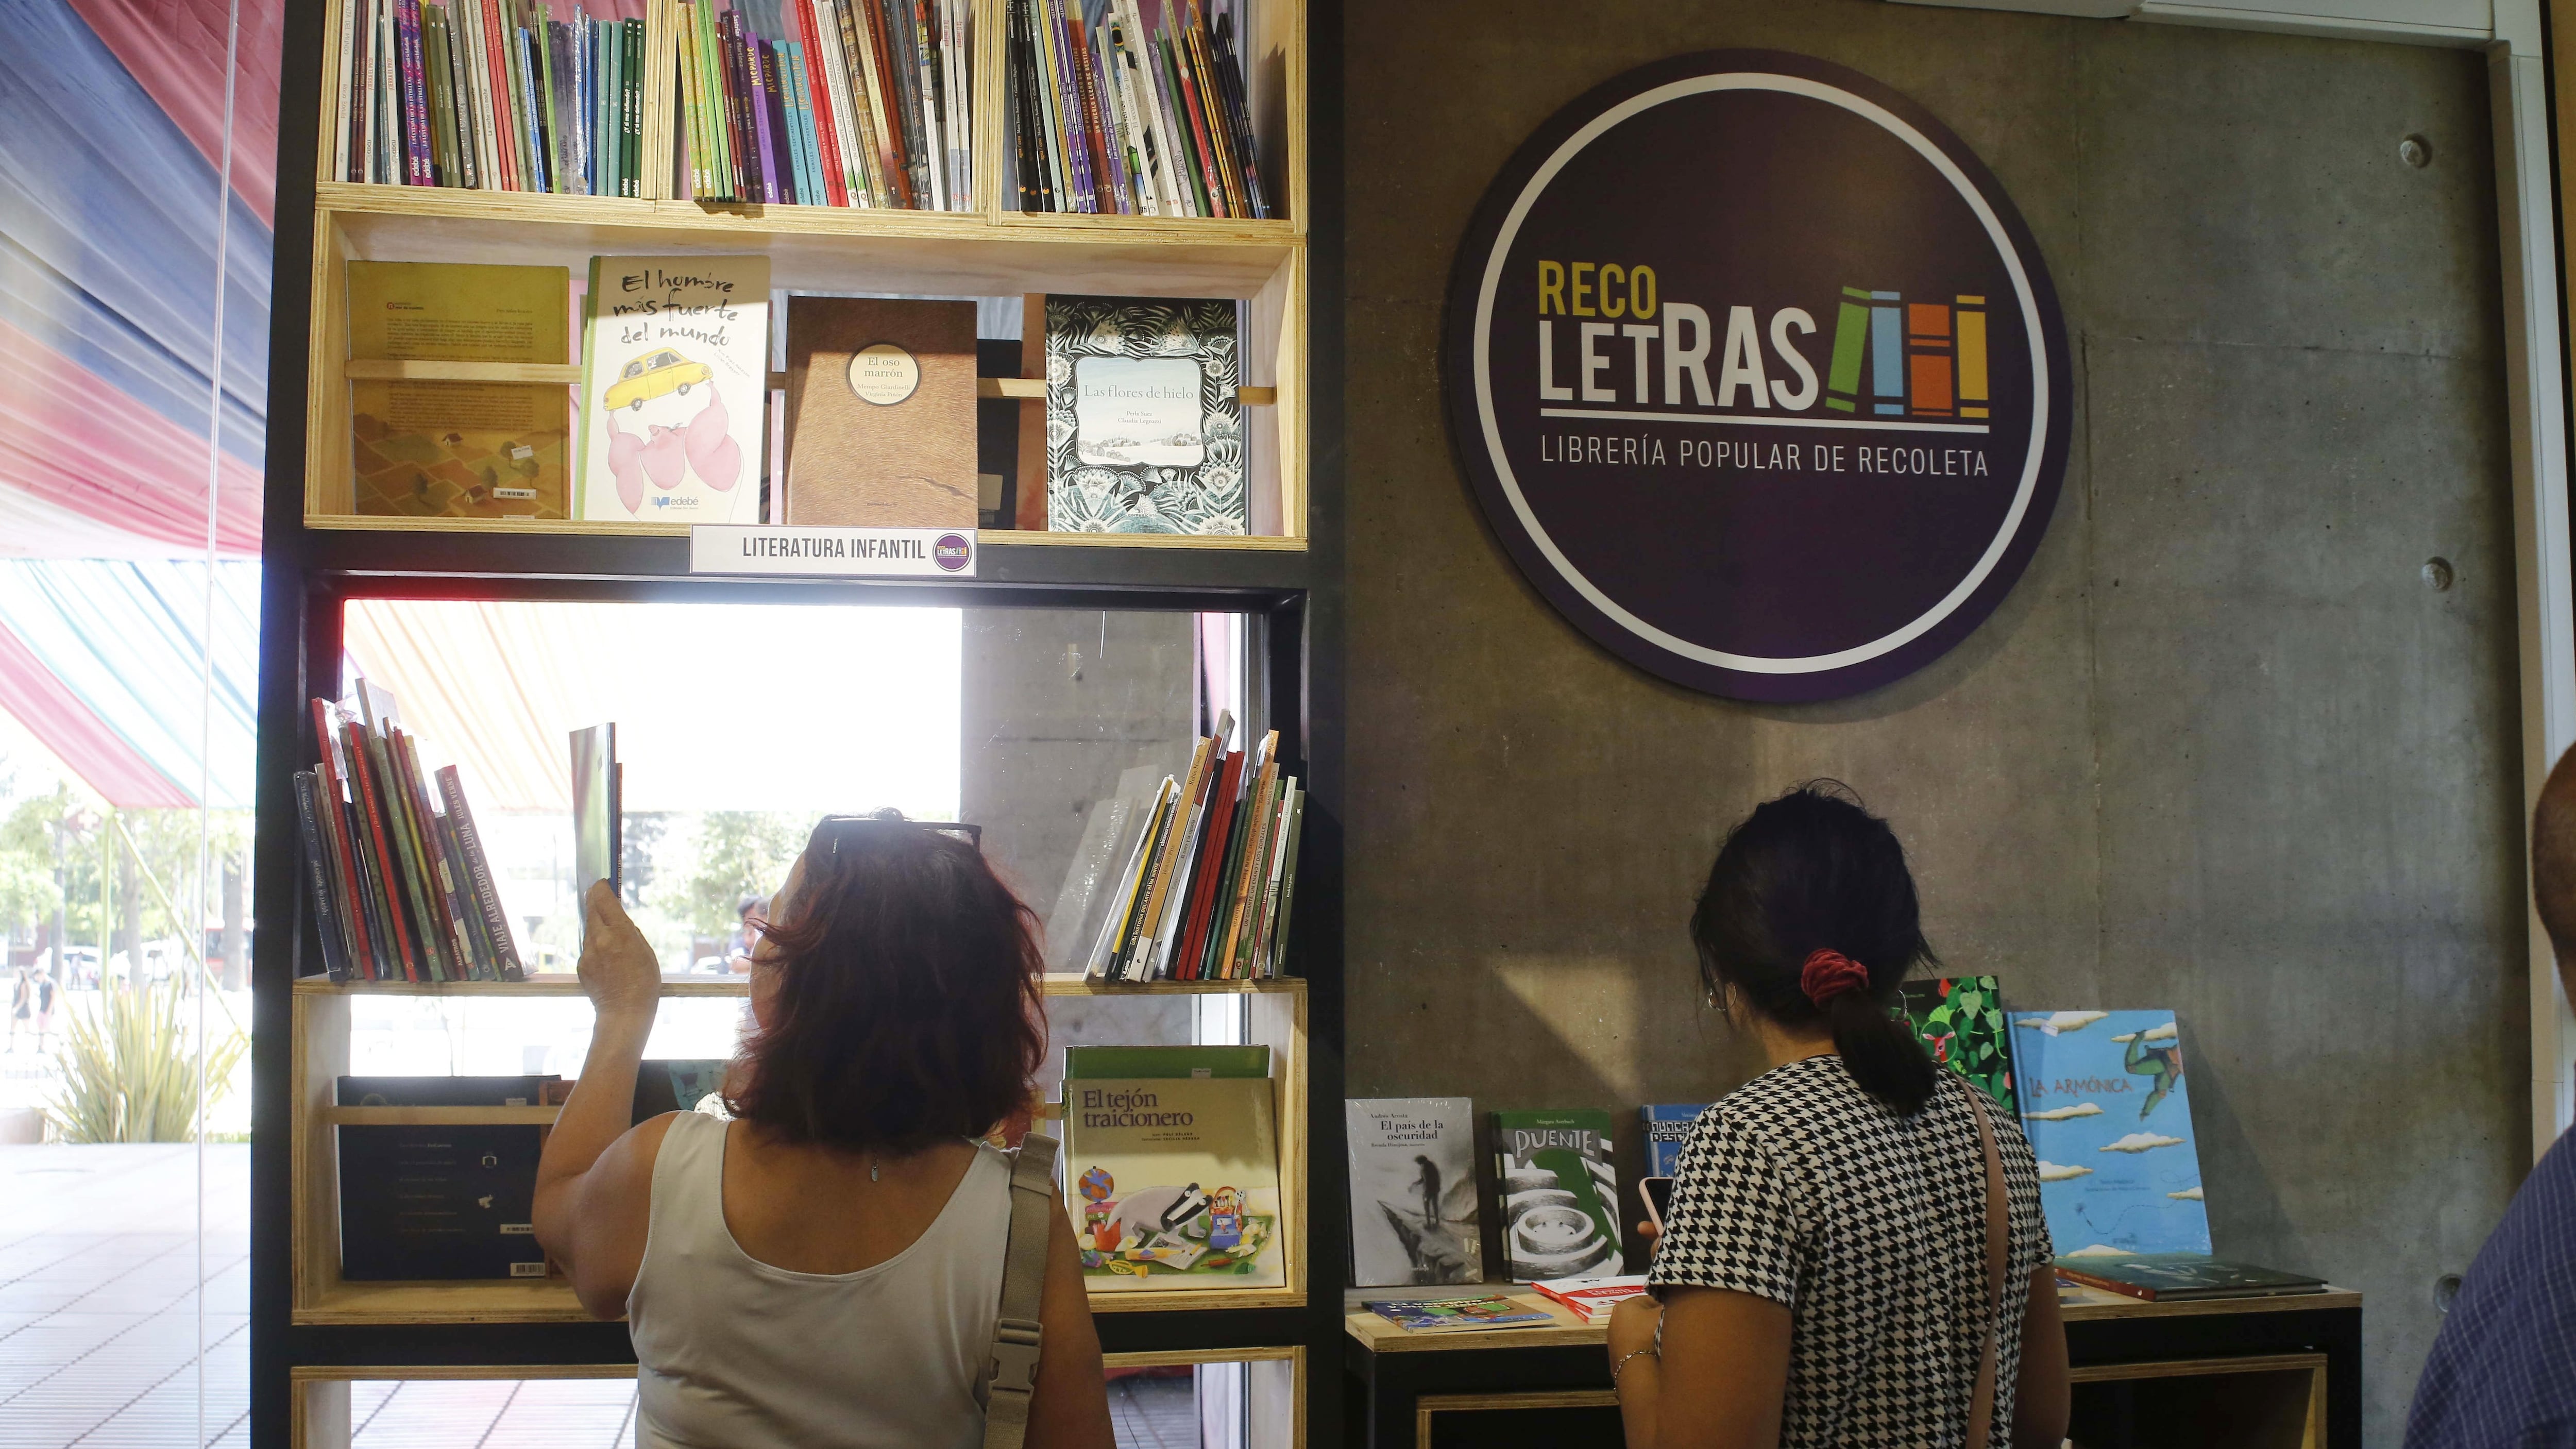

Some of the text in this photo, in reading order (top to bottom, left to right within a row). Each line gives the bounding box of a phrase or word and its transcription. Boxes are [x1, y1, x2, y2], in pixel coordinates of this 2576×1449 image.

[747, 46, 762, 86] MIOPARDO
[1073, 47, 1081, 71] BESTIAS
[1082, 47, 1091, 71] BESTIAS
[762, 55, 777, 93] MIOPARDO
[827, 58, 836, 87] ZORZALES
[836, 59, 845, 89] ZORZALES
[1121, 61, 1130, 82] Benito
[1088, 82, 1096, 102] LLENO
[1128, 92, 1137, 119] secuestro
[788, 112, 797, 146] SENTIMENTALES
[1095, 125, 1100, 133] UN
[423, 158, 432, 178] edebé
[622, 270, 649, 292] El
[1538, 260, 1657, 319] RECO
[614, 288, 738, 322] más fuerte
[621, 322, 730, 346] del mundo
[868, 357, 878, 365] El
[1539, 302, 1819, 411] LETRAS
[865, 369, 903, 377] marrón
[1085, 384, 1194, 399] Las flores de hielo
[1541, 433, 1989, 477] LIBRERÍA POPULAR DE RECOLETA
[670, 497, 699, 506] edebé
[743, 537, 925, 559] LITERATURA INFANTIL
[1189, 771, 1198, 785] Robin
[1268, 770, 1277, 789] SIFFREDI
[445, 776, 465, 819] JULES VERNE
[1252, 814, 1261, 826] sabe
[460, 822, 476, 850] LUNA
[1150, 863, 1159, 878] NIÑOS
[1245, 894, 1255, 918] GIGANTE,
[1257, 823, 1267, 849] ZORZALES
[474, 864, 499, 922] ALREDEDOR
[1146, 878, 1155, 889] PARA
[1134, 913, 1145, 935] HISTORIA
[1232, 904, 1241, 927] palabras
[494, 925, 509, 953] VIAJE
[452, 938, 463, 966] ALBATROS
[2029, 1077, 2048, 1097] LA
[2055, 1075, 2134, 1097] ARMÓNICA
[1083, 1088, 1158, 1112] El tejón
[1083, 1109, 1193, 1127] traicionero
[1381, 1120, 1443, 1133] El país de la
[1652, 1122, 1688, 1131] NUNCA
[1387, 1130, 1438, 1140] oscuridad
[1515, 1130, 1595, 1158] PUENTE
